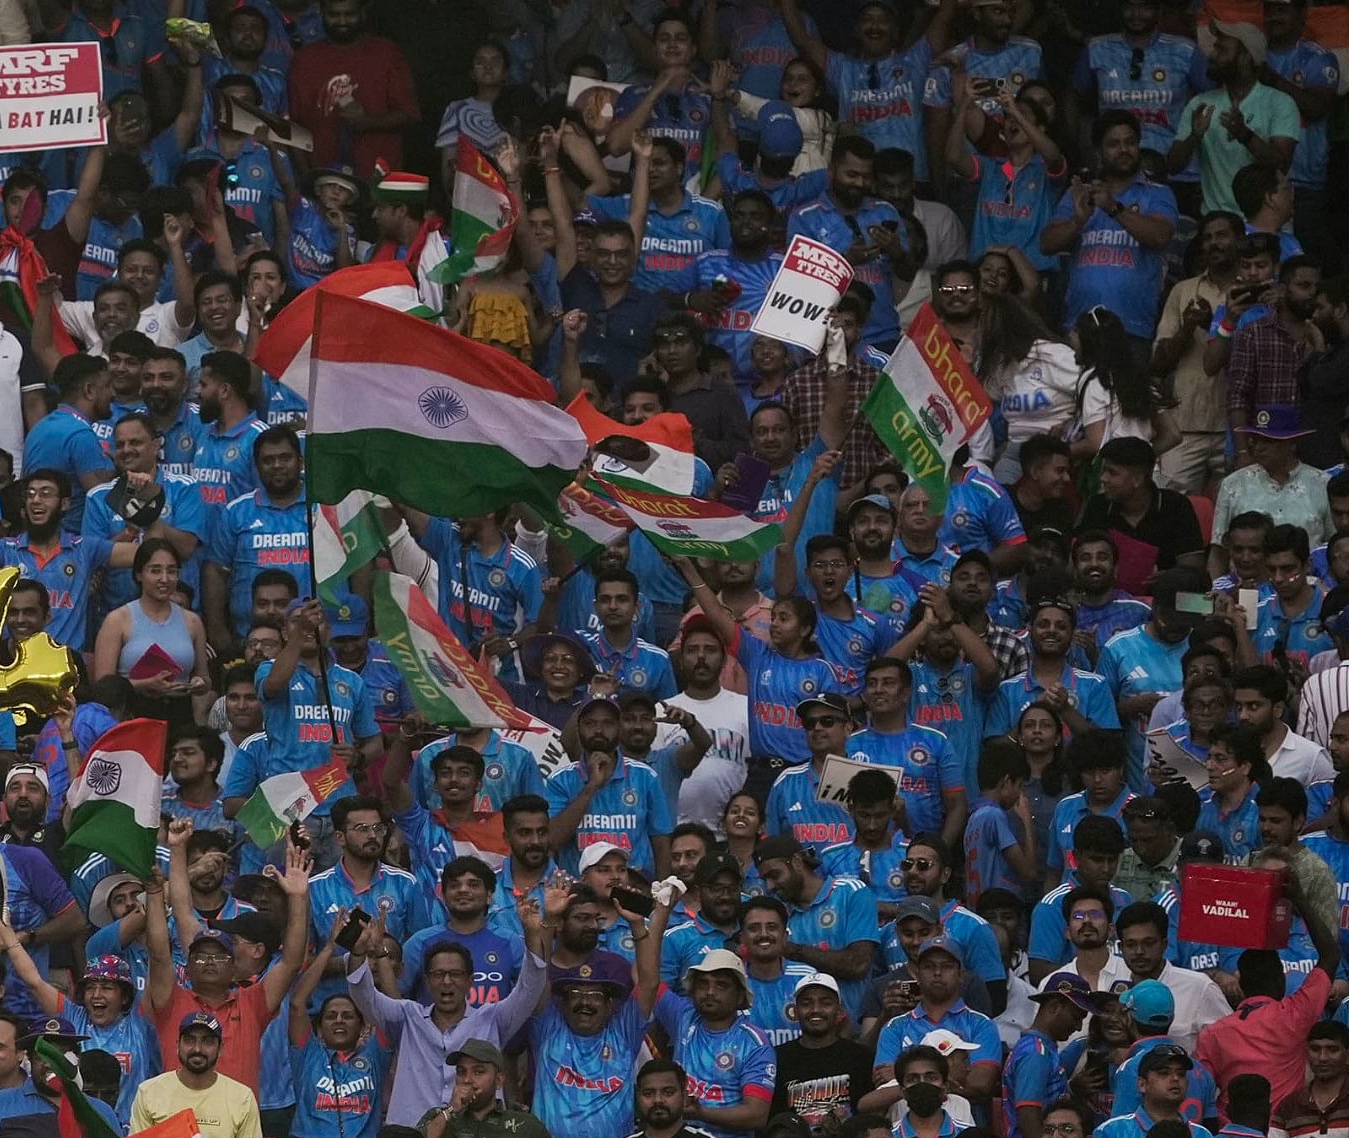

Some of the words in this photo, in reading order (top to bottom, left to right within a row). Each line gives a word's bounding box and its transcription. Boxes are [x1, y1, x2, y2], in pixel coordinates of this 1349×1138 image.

[7, 107, 45, 129] BAT
[791, 242, 850, 273] MRF
[796, 259, 843, 287] TYRES
[890, 410, 942, 475] army
[253, 534, 307, 548] DREAM
[258, 549, 309, 565] INDIA
[917, 704, 962, 723] INDIA
[575, 815, 636, 830] DREAM11
[793, 824, 852, 843] INDIA
[1202, 906, 1249, 919] VADILAL
